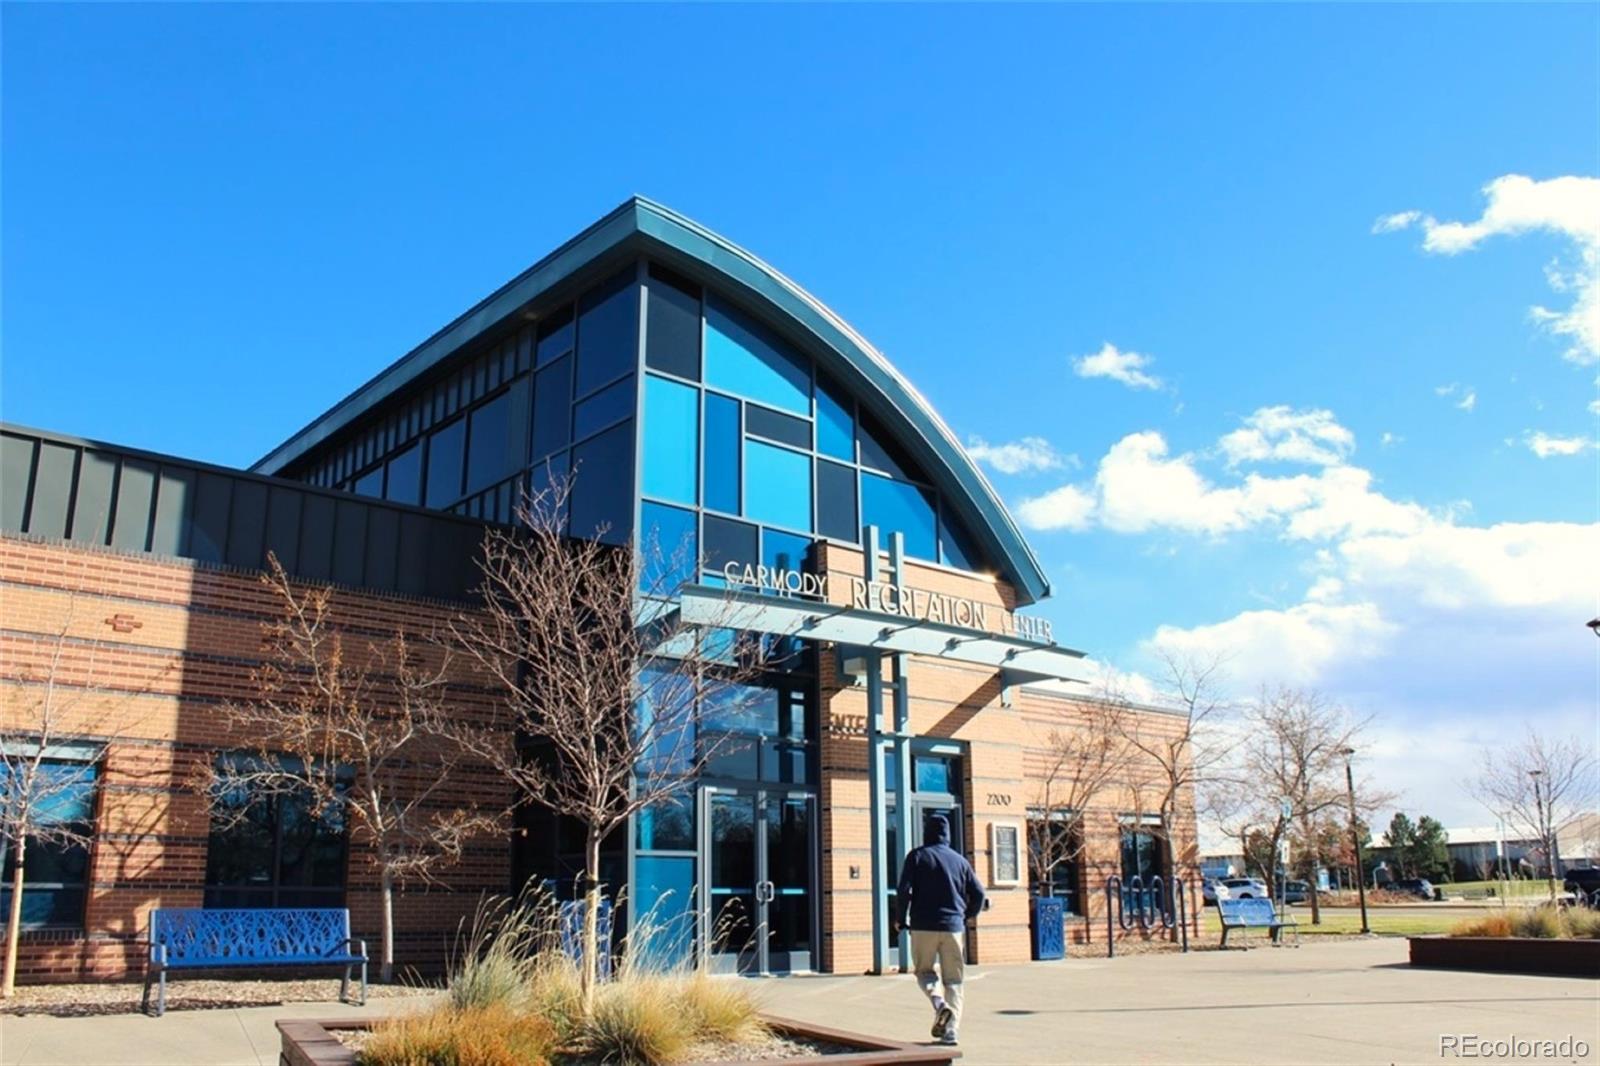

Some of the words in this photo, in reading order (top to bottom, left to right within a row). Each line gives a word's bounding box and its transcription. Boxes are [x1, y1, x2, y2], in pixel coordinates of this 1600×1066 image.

[724, 561, 827, 597] CARMODY
[851, 578, 987, 629] RECREATION
[1001, 611, 1053, 643] CENTER
